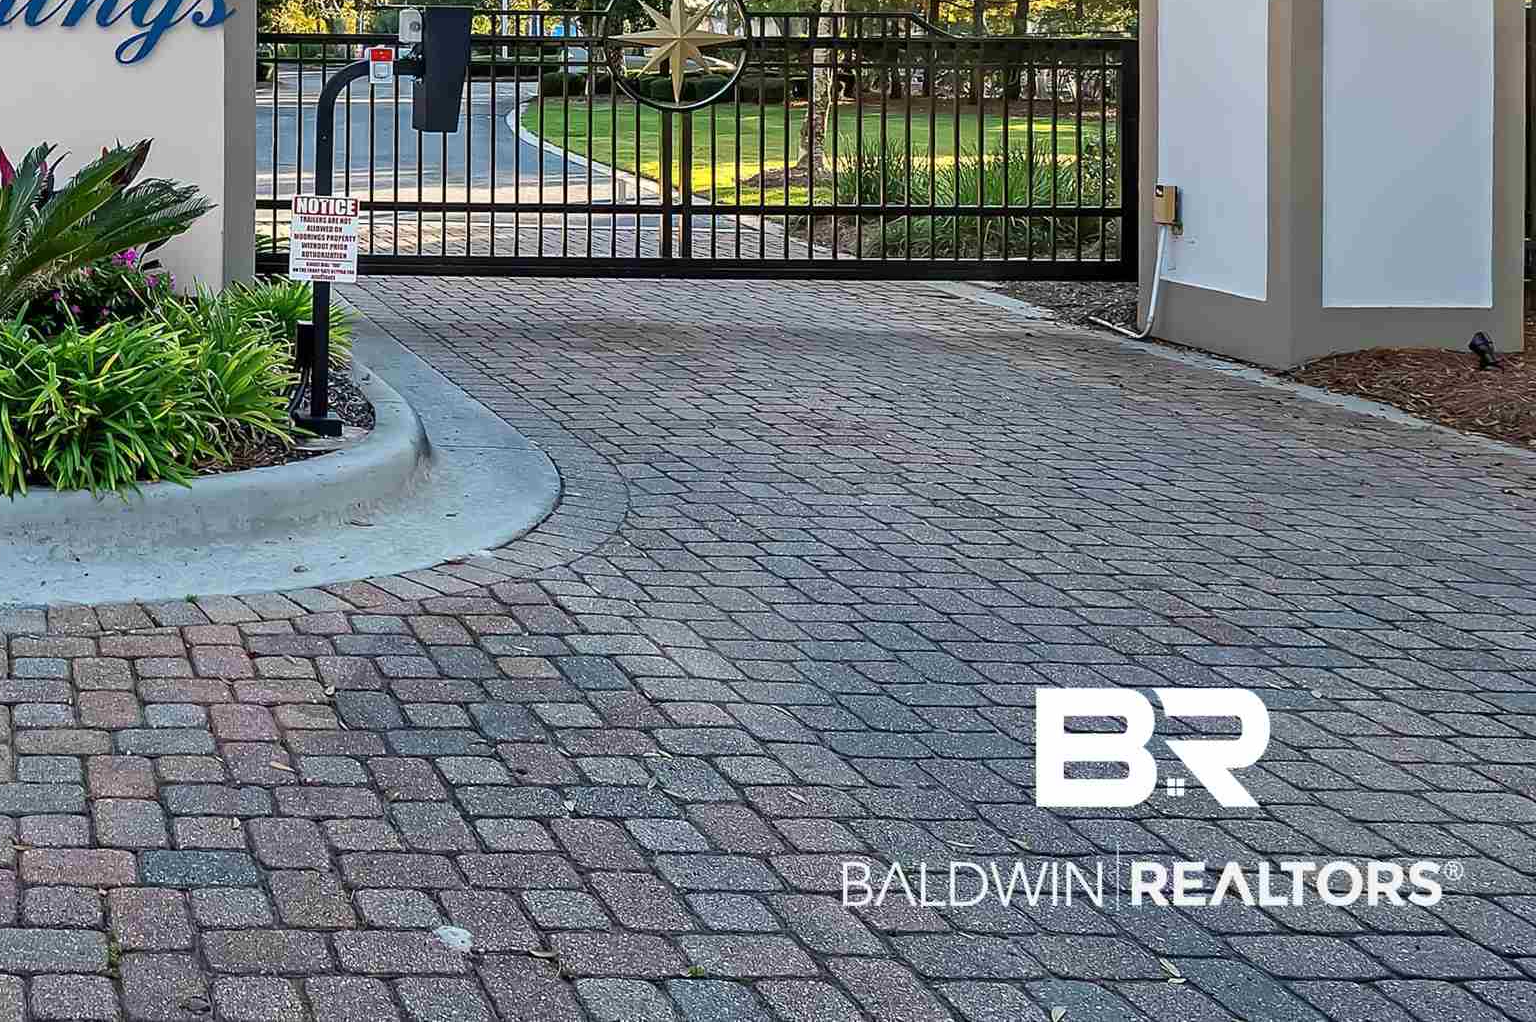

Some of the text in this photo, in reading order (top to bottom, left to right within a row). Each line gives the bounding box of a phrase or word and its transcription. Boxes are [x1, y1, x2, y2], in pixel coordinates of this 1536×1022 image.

[296, 198, 356, 216] NOTICE
[339, 217, 352, 225] NOT
[307, 225, 333, 233] ALLOWED
[294, 233, 356, 242] MOORINGS PROPERTY
[301, 242, 348, 251] WITHOUT PRIOR
[301, 251, 347, 259] AUTHORIZATION
